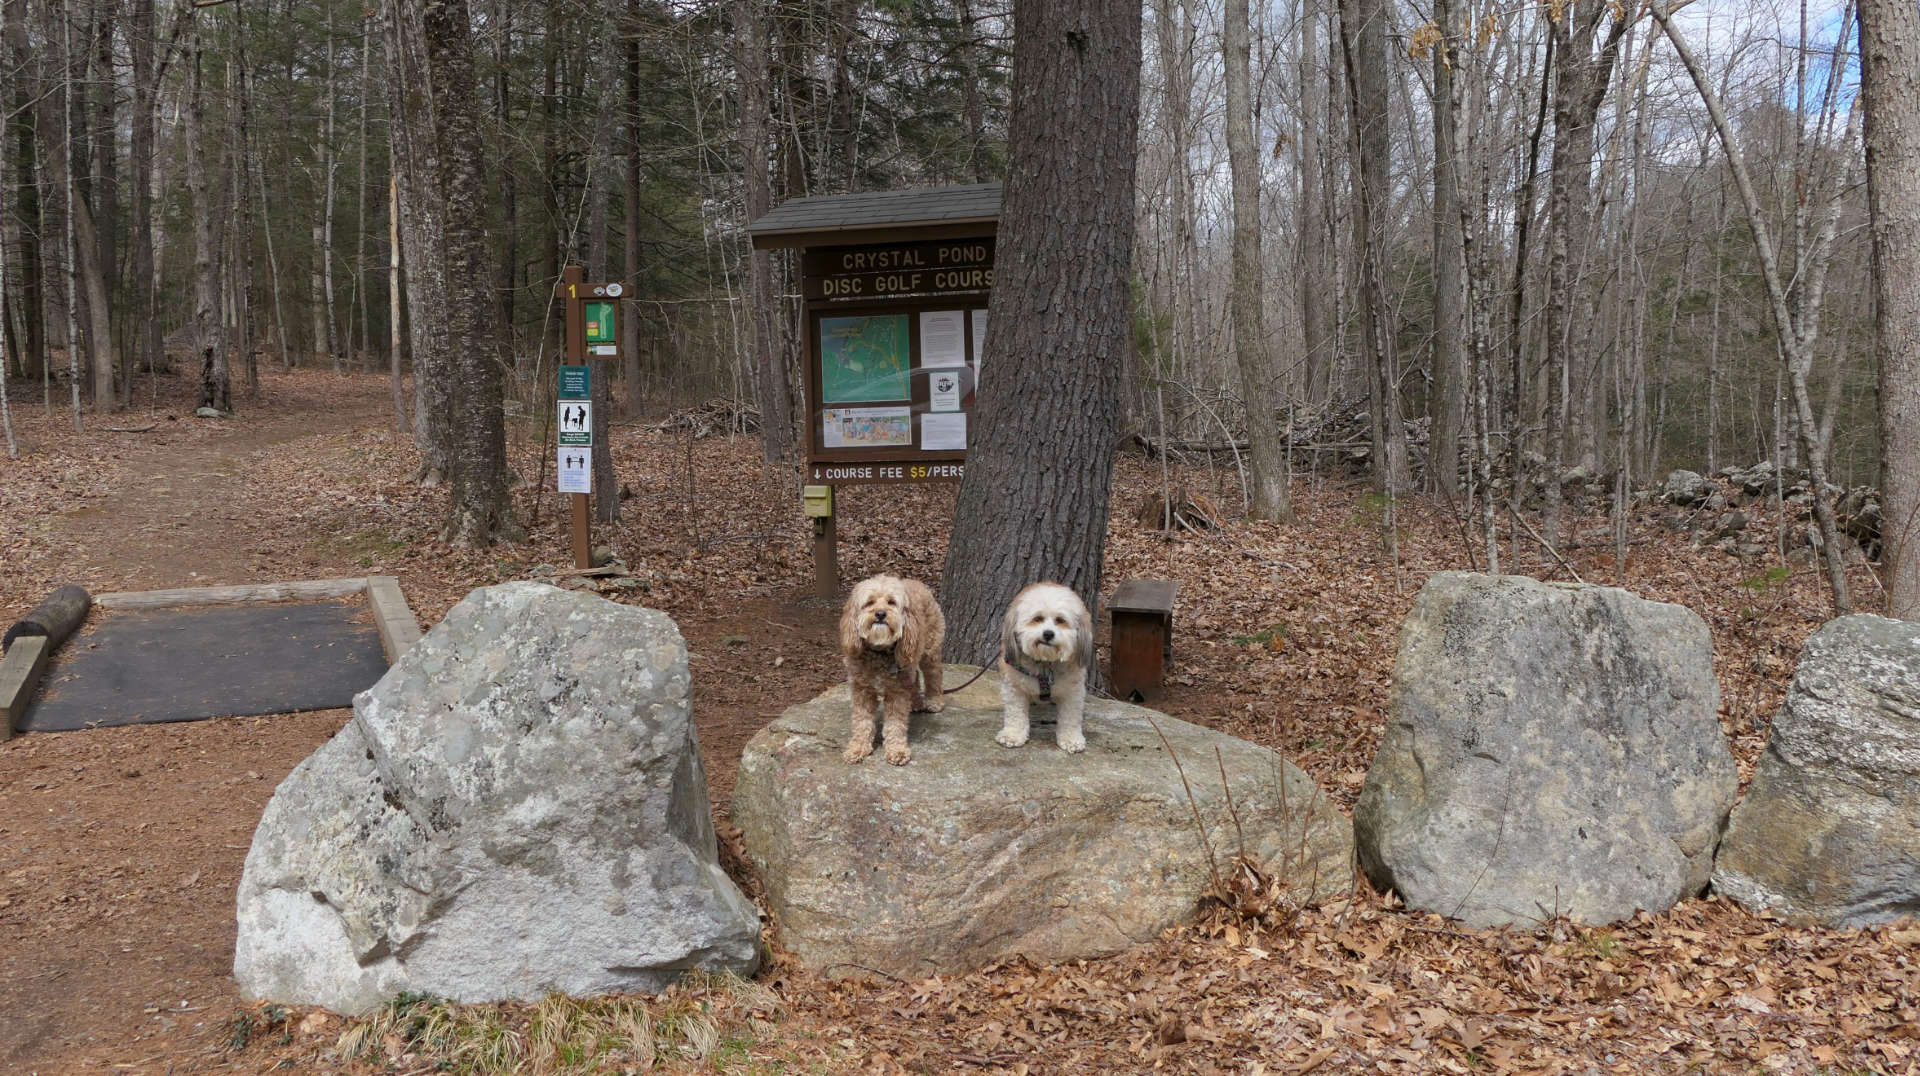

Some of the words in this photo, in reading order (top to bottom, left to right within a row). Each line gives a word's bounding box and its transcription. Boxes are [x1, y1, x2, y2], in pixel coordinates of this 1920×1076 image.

[843, 250, 925, 270] CRYSTAL
[939, 245, 987, 264] POND
[568, 284, 576, 299] 1
[823, 278, 863, 296] DISC
[875, 273, 922, 292] GOLF
[826, 467, 873, 480] COURSE
[879, 466, 904, 479] FEE
